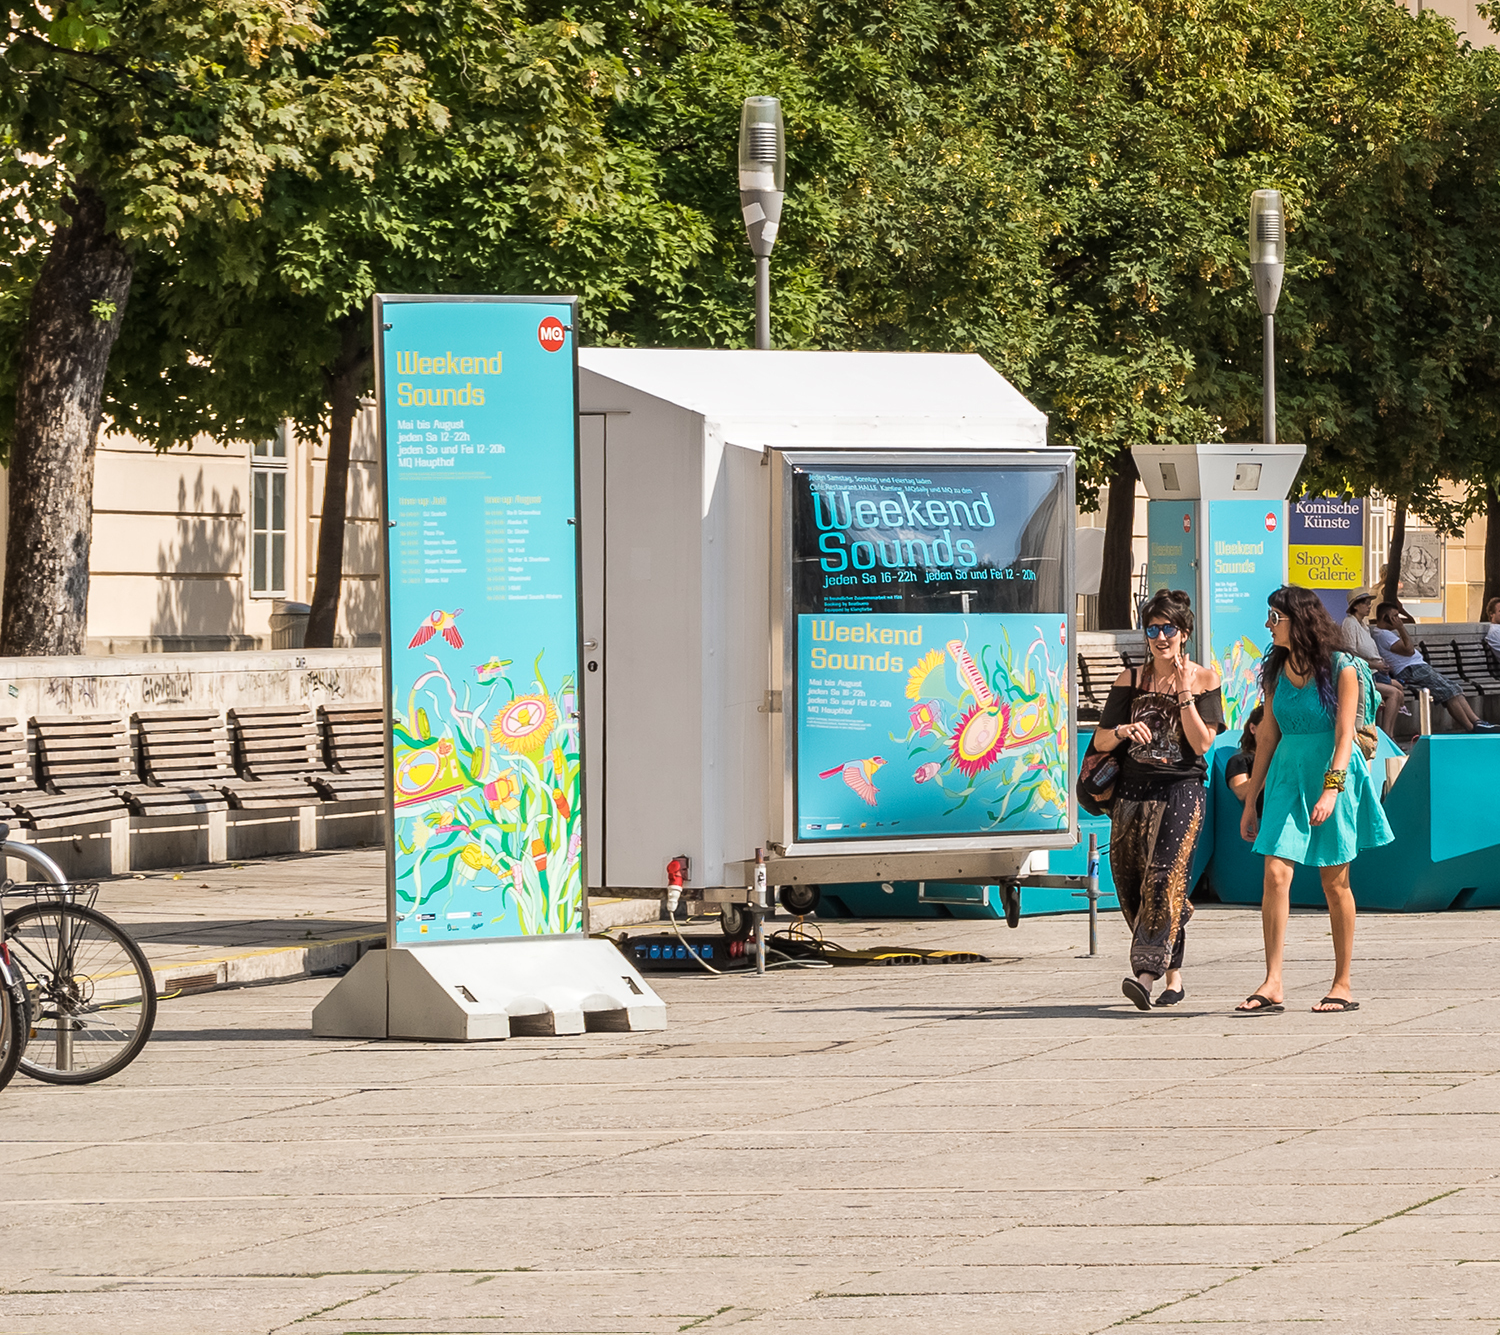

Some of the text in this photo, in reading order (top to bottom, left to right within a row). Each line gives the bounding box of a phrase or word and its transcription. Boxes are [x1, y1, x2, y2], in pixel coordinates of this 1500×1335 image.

[540, 327, 564, 341] MQ
[396, 350, 502, 374] Weekend
[397, 382, 485, 406] Sounds
[397, 420, 464, 431] Mai bis August
[397, 431, 470, 444] jeden Sa 12-22h
[397, 444, 505, 456] jeden So und Fei 12-20h
[398, 457, 454, 469] MQ Haupthof
[811, 491, 996, 531] Weekend
[1295, 501, 1359, 514] Komische
[1303, 515, 1350, 528] Künste
[818, 529, 978, 572] Sounds
[1214, 540, 1264, 555] Weekend
[1214, 559, 1255, 574] Sounds
[1296, 552, 1343, 568] Shop &
[823, 574, 857, 588] jeden
[862, 572, 877, 584] Sa
[881, 572, 917, 583] 16-22h
[924, 569, 953, 584] jeden
[956, 570, 968, 580] So
[970, 569, 988, 580] und
[990, 570, 1003, 580] Fei
[1006, 570, 1014, 580] 12
[1022, 569, 1036, 581] 20h
[1308, 567, 1356, 581] Galerie
[811, 620, 923, 645] Weekend
[811, 647, 904, 673] Sounds
[837, 680, 862, 688] August
[821, 707, 853, 715] Haupthof
